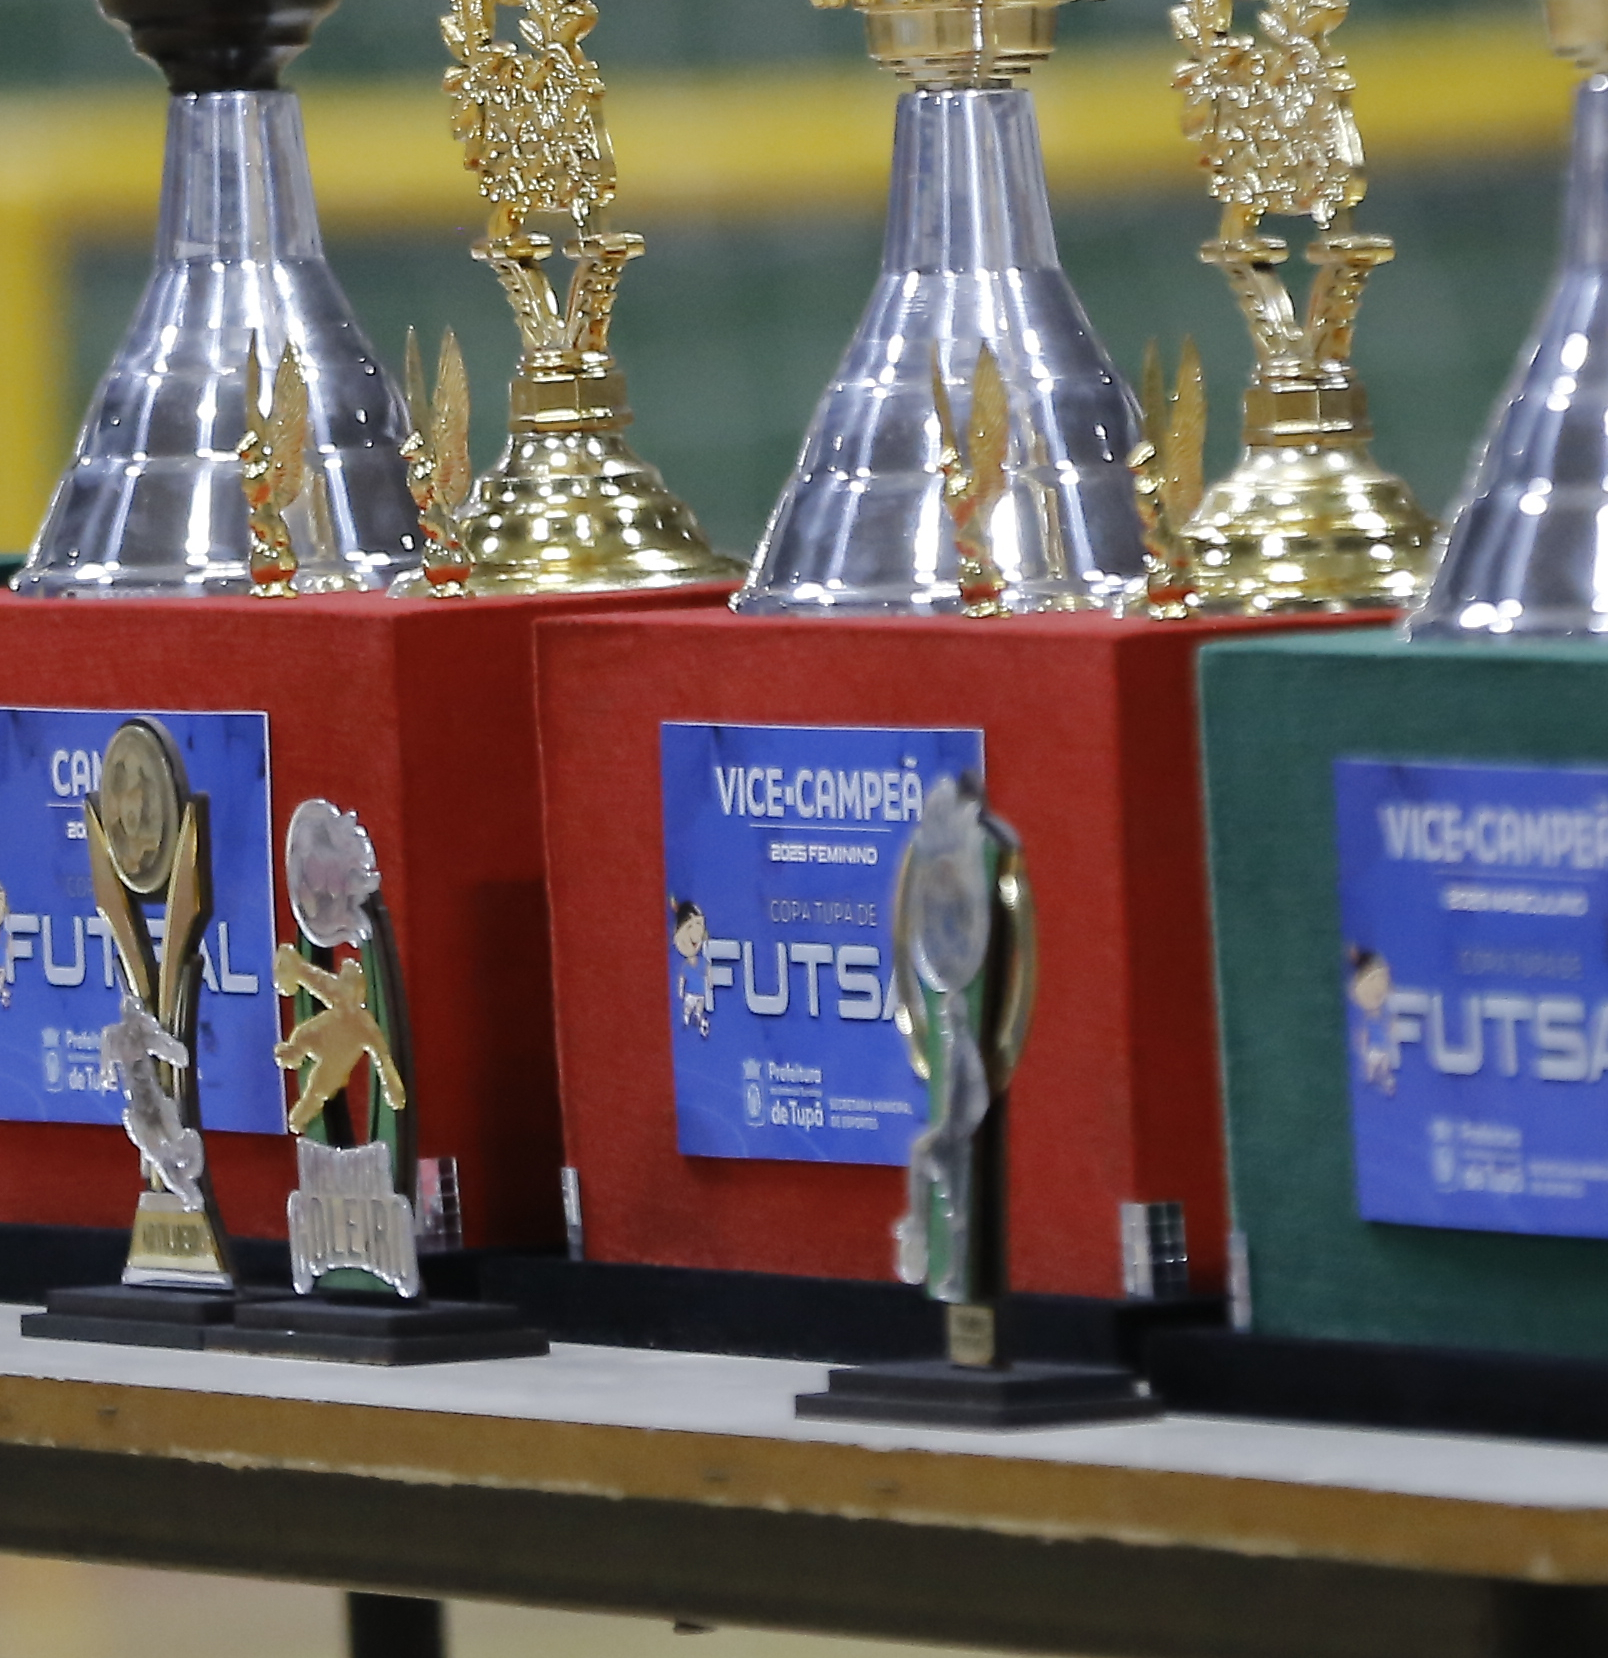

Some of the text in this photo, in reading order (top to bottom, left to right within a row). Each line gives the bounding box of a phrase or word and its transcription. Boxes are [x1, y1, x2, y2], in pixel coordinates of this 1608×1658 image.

[771, 843, 879, 866] 2025 FEMININO
[771, 900, 811, 923] COPA
[858, 903, 879, 927] DE
[771, 1100, 789, 1126] de
